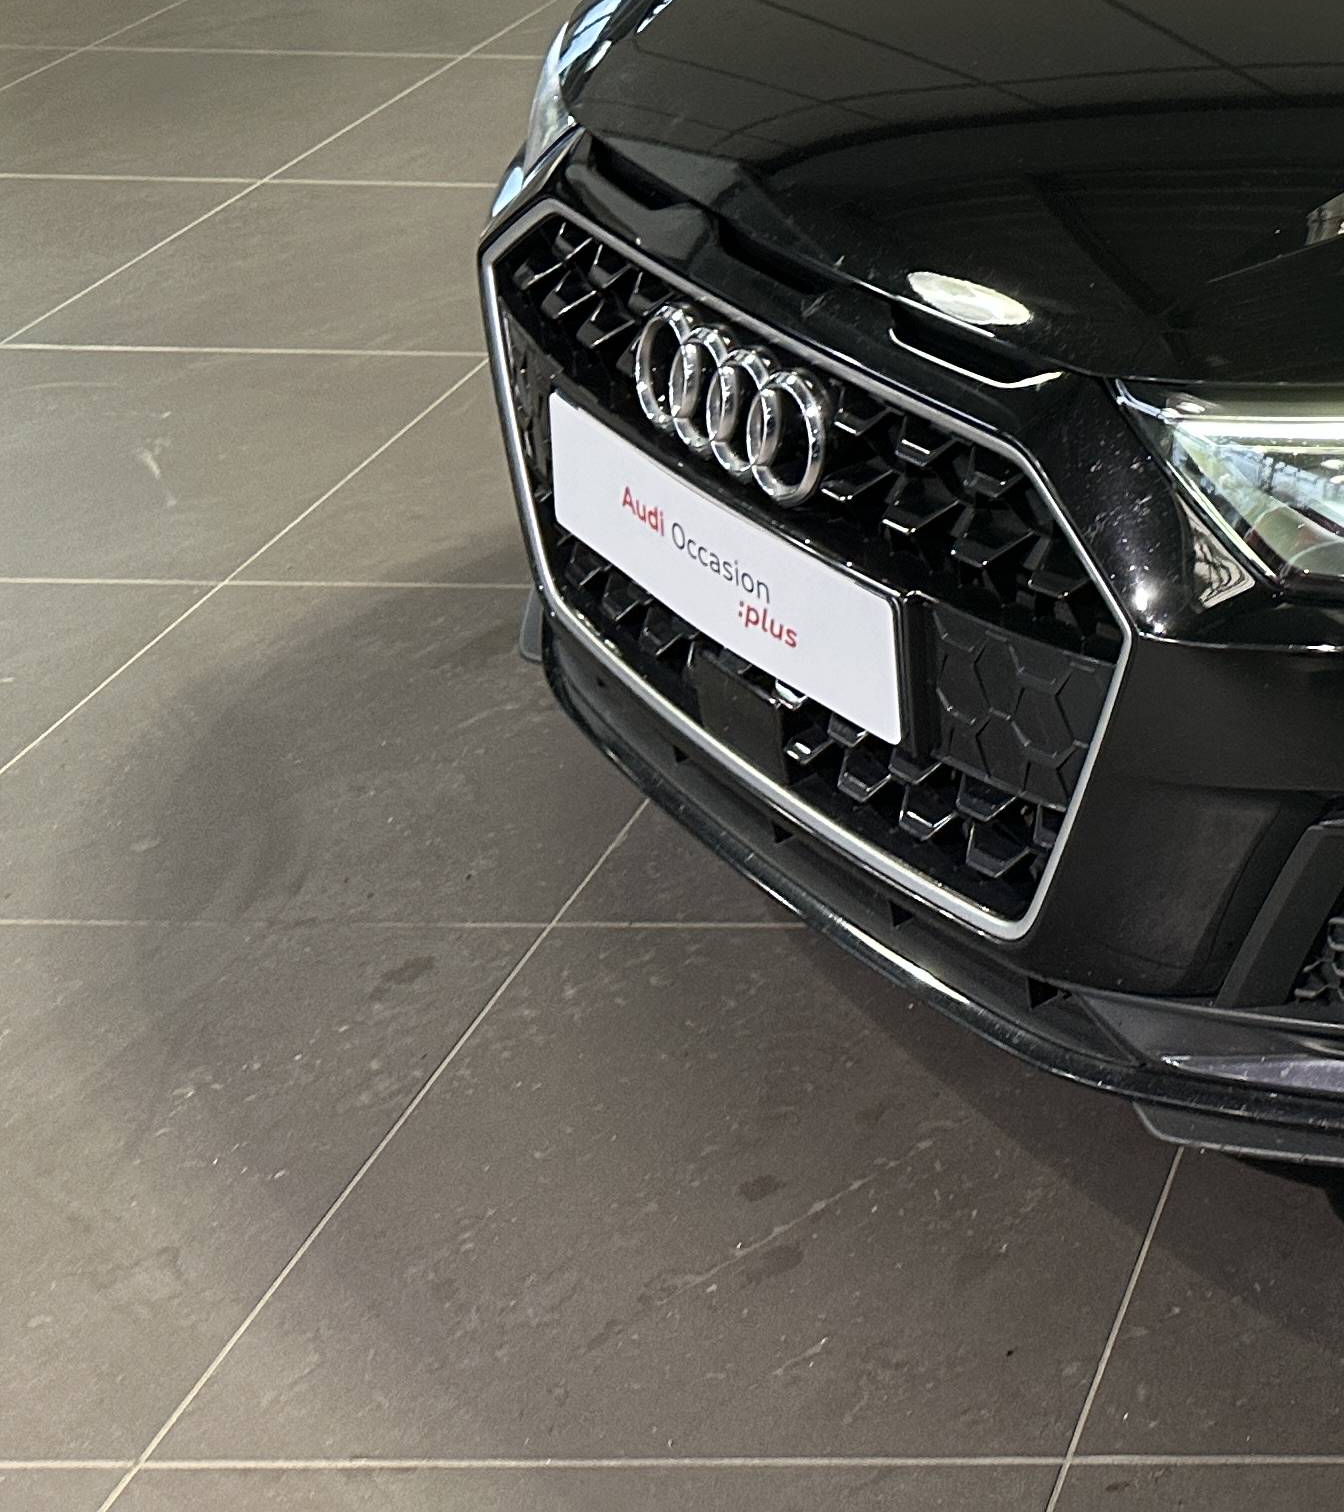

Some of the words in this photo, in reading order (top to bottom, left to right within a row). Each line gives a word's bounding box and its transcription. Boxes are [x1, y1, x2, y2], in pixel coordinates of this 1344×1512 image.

[622, 486, 665, 537] Audi
[671, 522, 771, 604] Occasion
[738, 600, 798, 648] :plus
